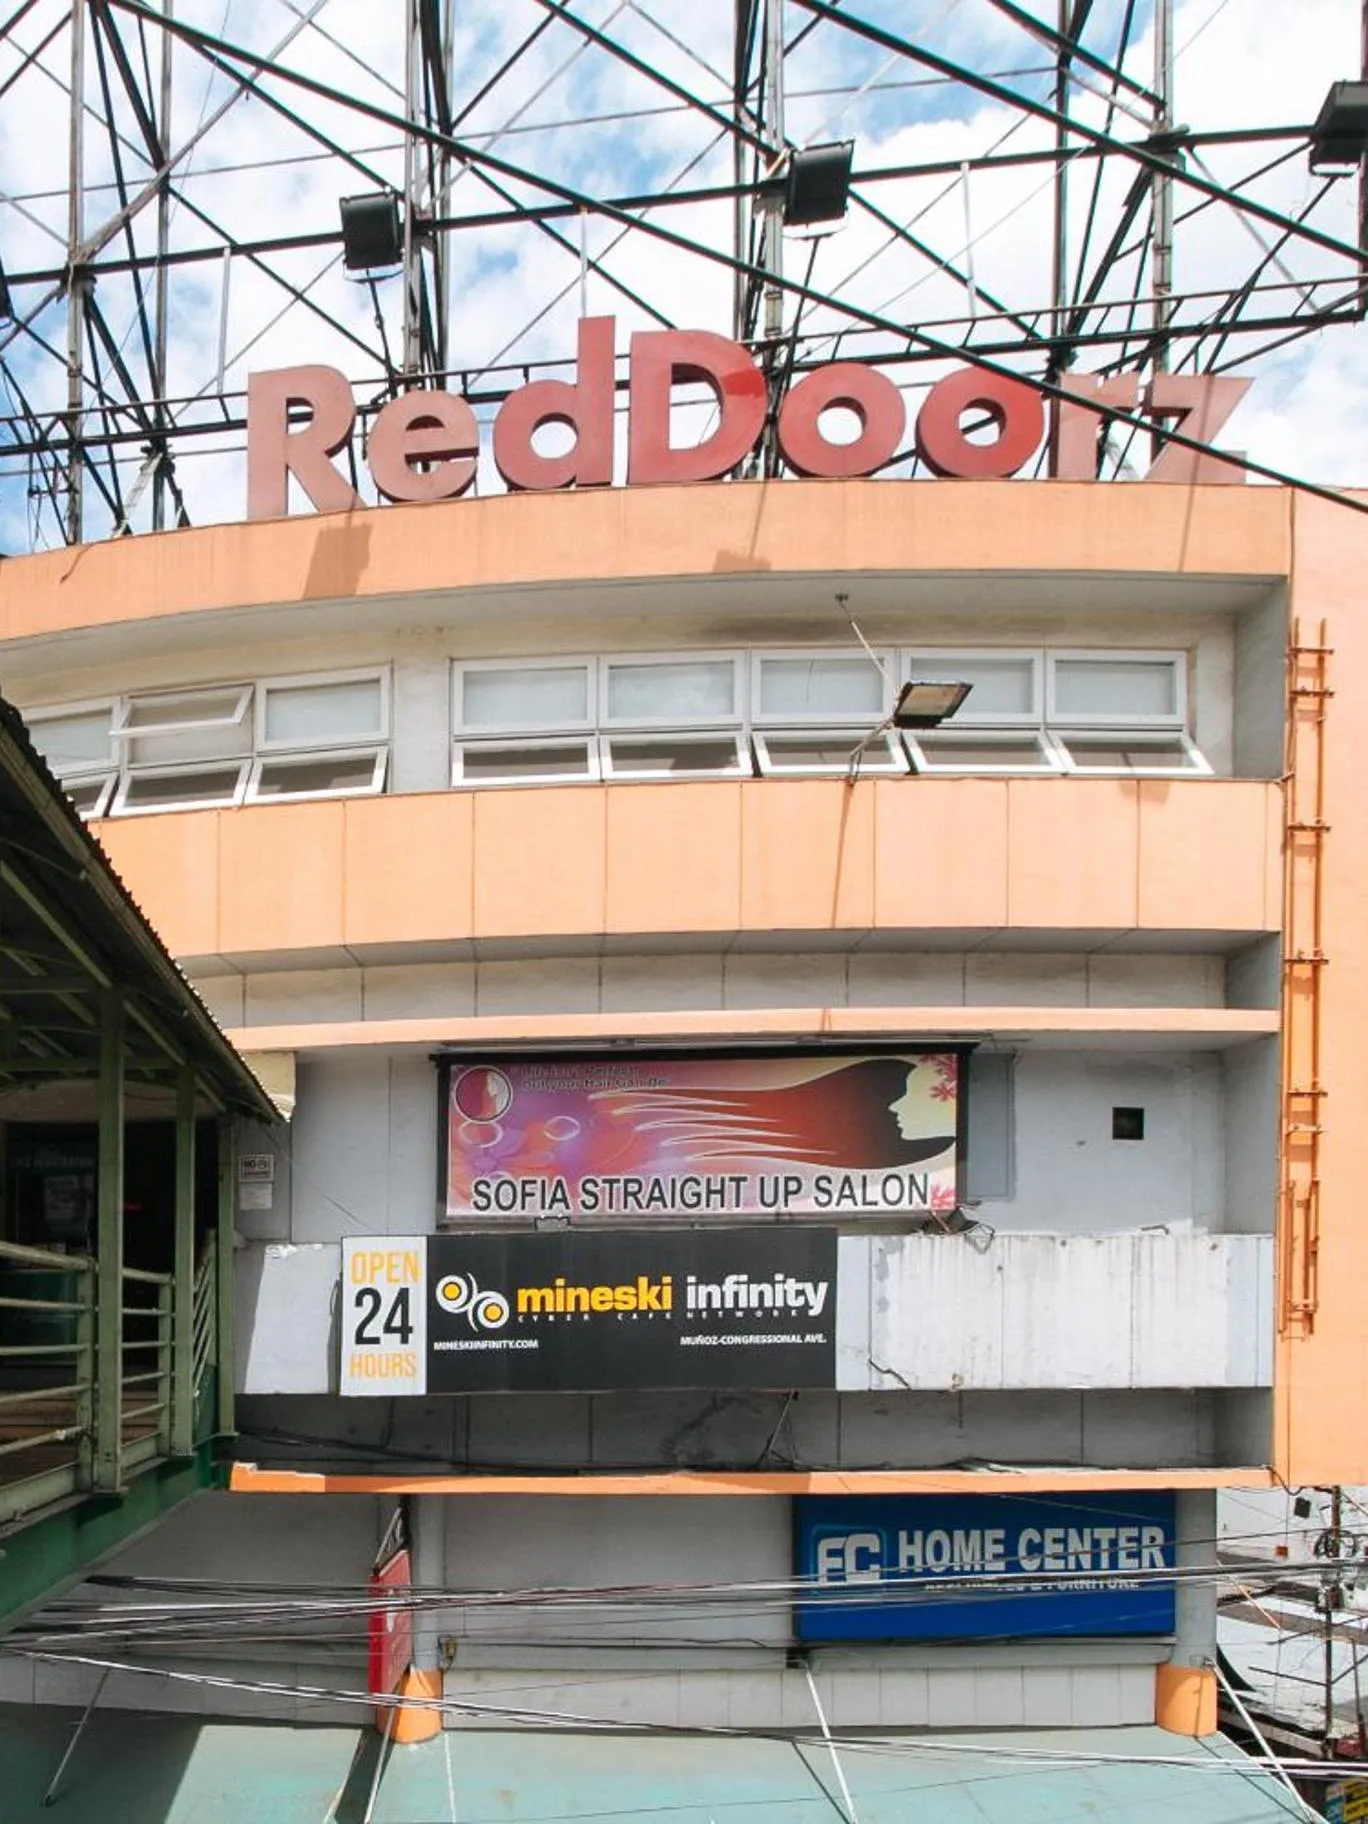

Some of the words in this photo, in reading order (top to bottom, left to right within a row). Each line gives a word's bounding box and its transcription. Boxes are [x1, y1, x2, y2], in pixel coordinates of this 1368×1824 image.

[246, 314, 1252, 520] RedDoorz
[471, 1176, 571, 1212] SOFIA
[579, 1174, 748, 1211] STRAIGHT
[759, 1174, 803, 1208] UP
[813, 1172, 930, 1208] SALON
[350, 1251, 420, 1285] OPEN
[354, 1287, 413, 1345] 24
[516, 1276, 673, 1313] mineski
[685, 1273, 830, 1317] infinity
[517, 1314, 591, 1323] CYBER
[617, 1312, 673, 1321] CAFE
[349, 1352, 416, 1379] HOURS
[898, 1529, 1006, 1573] HOME
[1017, 1526, 1166, 1571] CENTER
